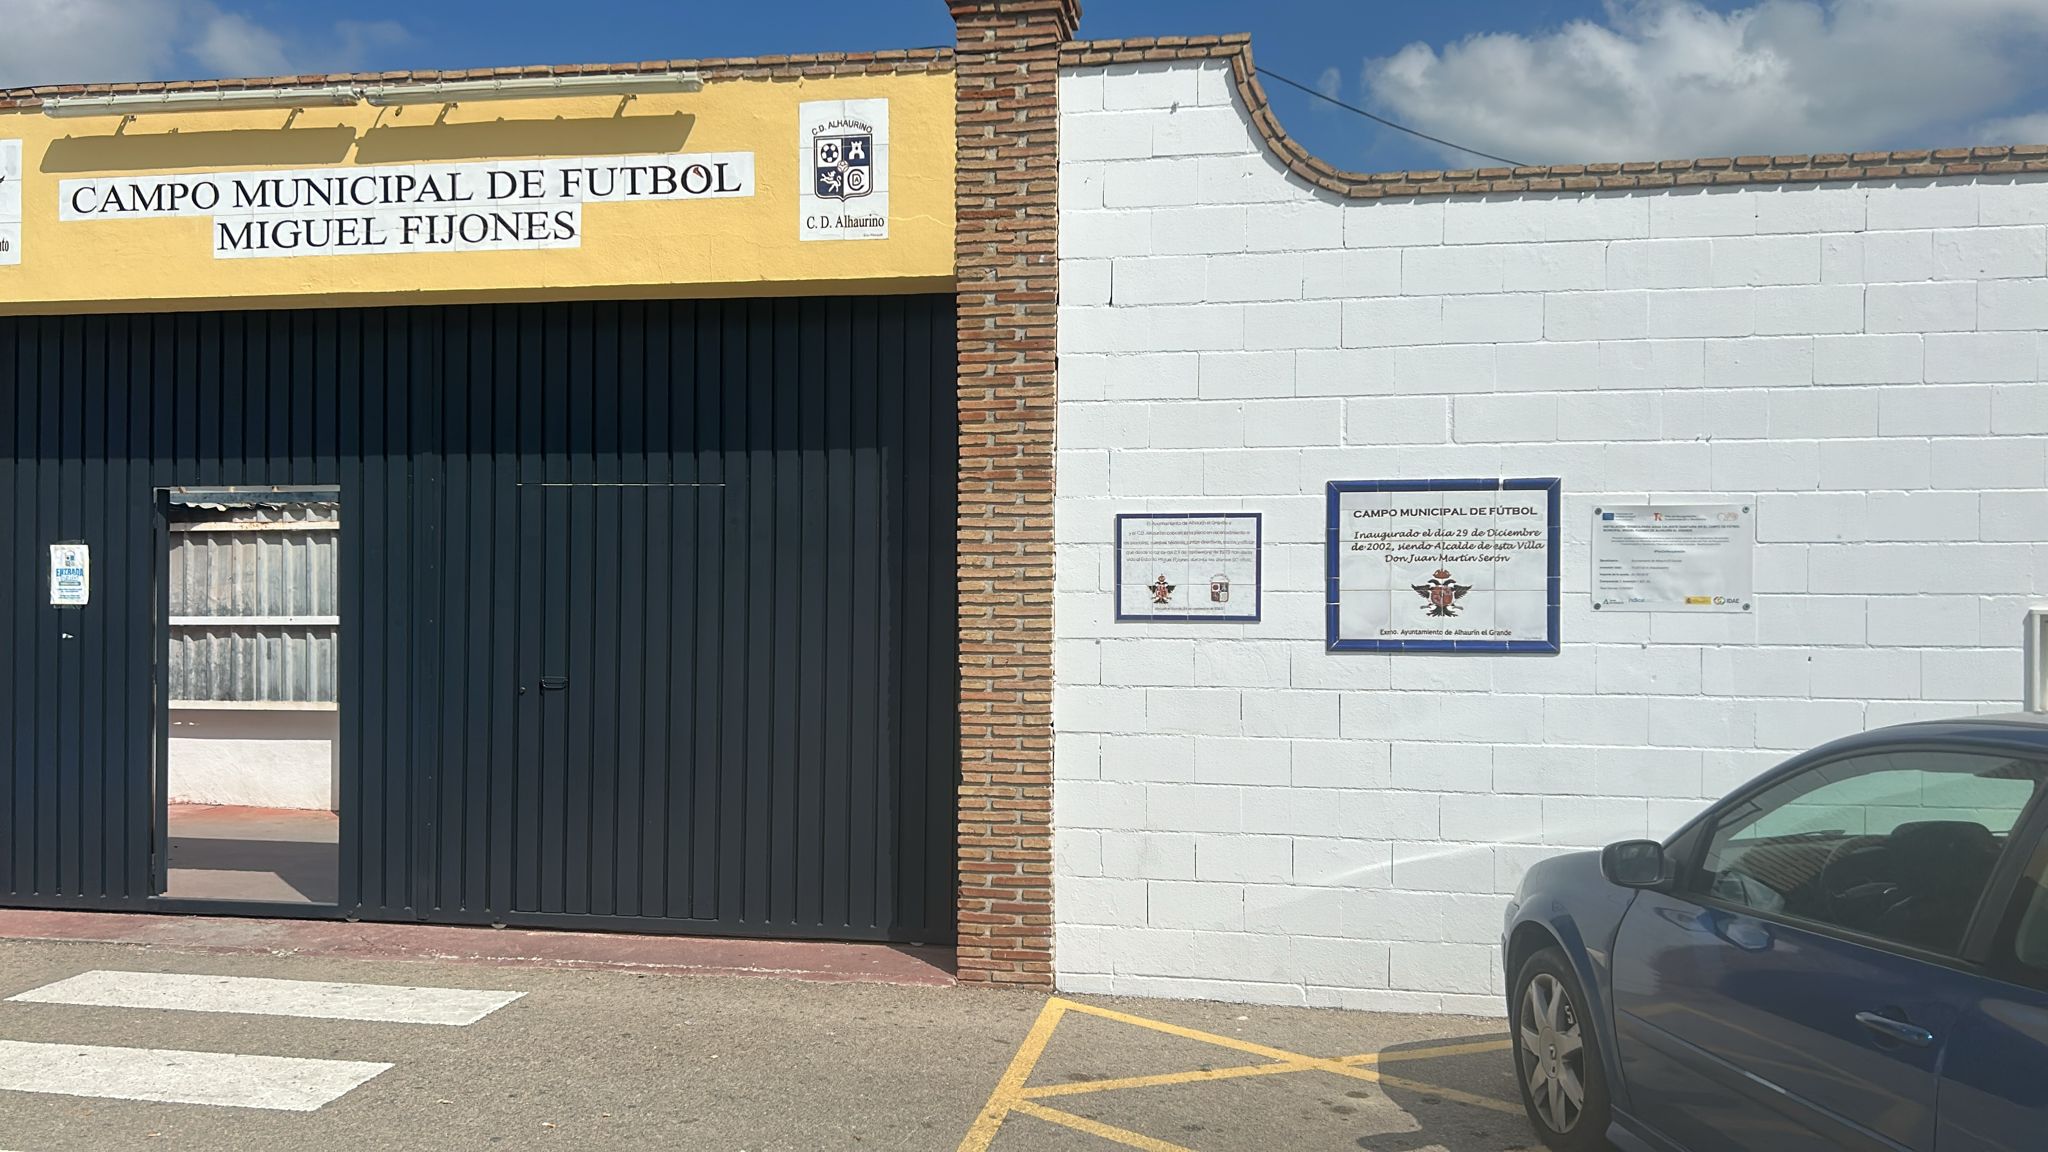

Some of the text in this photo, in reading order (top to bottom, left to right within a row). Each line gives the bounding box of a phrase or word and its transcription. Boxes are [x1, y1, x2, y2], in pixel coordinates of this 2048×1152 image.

[812, 120, 873, 136] C.D. ALHAURINO
[72, 162, 742, 214] CAMPO MUNICIPAL DE FUTBOL
[806, 213, 885, 229] C. D. Alhaurino
[217, 210, 577, 250] MIGUEL FIJONES
[1353, 505, 1538, 518] CAMPO MUNICIPAL DE FÚTBOL
[1354, 527, 1542, 541] Inaugurado el día 29 de Diciembre
[1351, 541, 1545, 551] de 2002, siendo Alcalde de esta Villa
[1385, 554, 1510, 563] Don Juan Martín Serón
[56, 568, 84, 577] ENTRADA
[1454, 628, 1480, 636] Alhaurín
